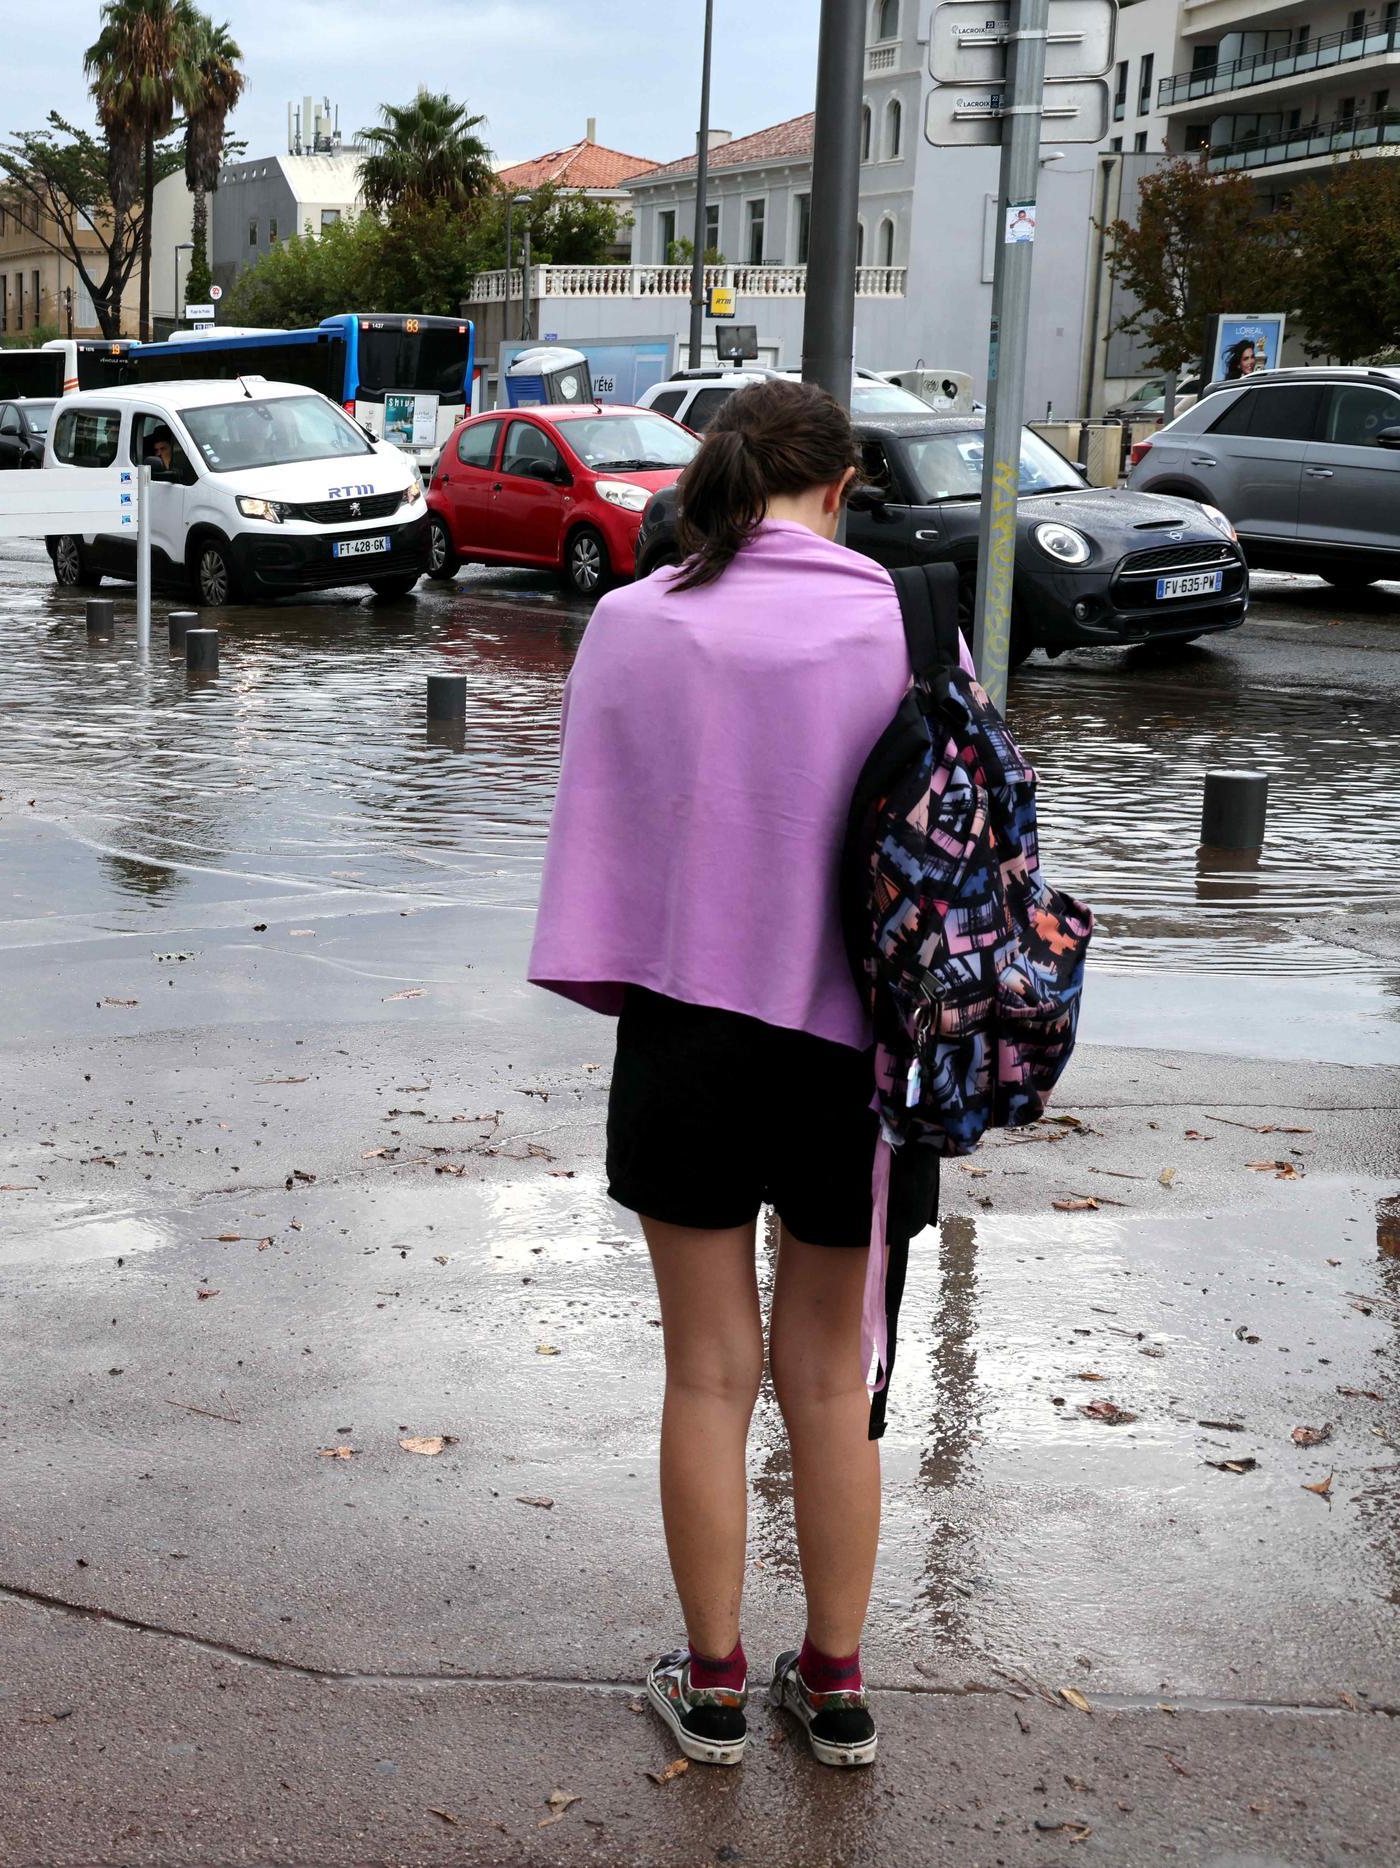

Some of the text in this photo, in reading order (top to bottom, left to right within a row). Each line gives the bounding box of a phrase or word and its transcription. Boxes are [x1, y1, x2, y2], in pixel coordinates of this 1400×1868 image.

[406, 319, 419, 332] 83
[112, 344, 120, 354] 19
[593, 375, 613, 392] l'Été
[328, 484, 375, 499] RTM
[339, 538, 385, 555] FT-428-GK
[1164, 575, 1215, 595] FV-635-PW
